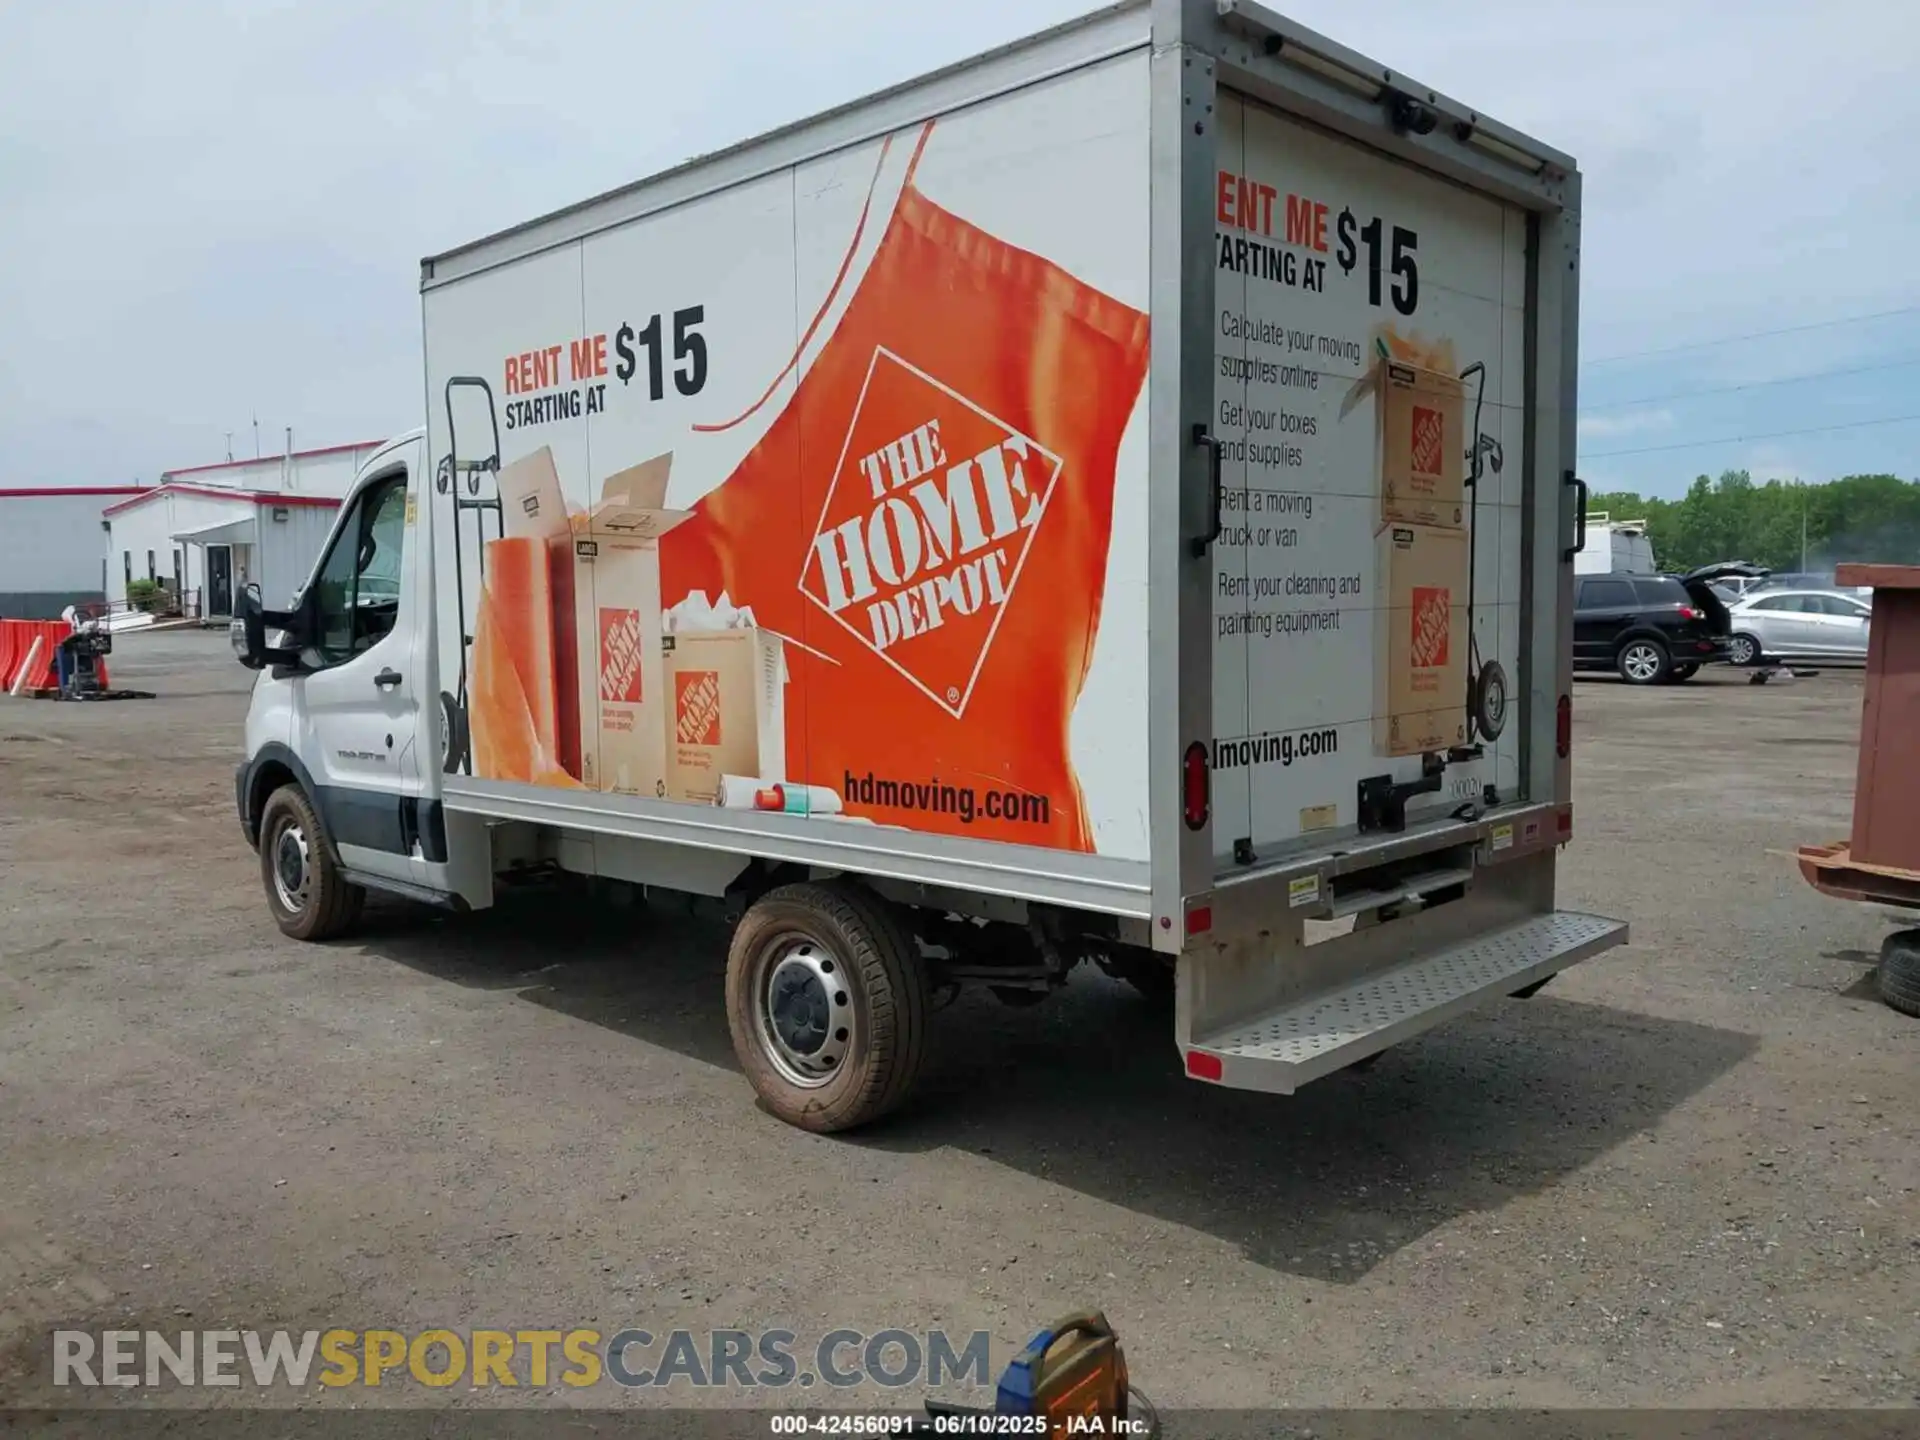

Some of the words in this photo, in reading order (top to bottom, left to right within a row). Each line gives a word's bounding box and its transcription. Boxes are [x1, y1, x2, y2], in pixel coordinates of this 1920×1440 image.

[1286, 193, 1329, 253] ME
[1303, 258, 1326, 293] AT
[1337, 205, 1418, 316] $15
[616, 304, 707, 401] $15
[1221, 310, 1283, 346] Calculate
[1287, 330, 1315, 353] your
[1319, 336, 1360, 366] moving
[505, 346, 562, 395] RENT
[570, 334, 608, 381] ME
[1221, 355, 1277, 385] supplies
[1281, 364, 1318, 390] online
[506, 390, 580, 429] STARTING
[587, 384, 606, 415] AT
[1220, 400, 1243, 426] Get
[1247, 409, 1277, 433] your
[1281, 407, 1317, 435] boxes
[860, 418, 947, 499] THE
[1220, 438, 1245, 461] and
[1249, 442, 1302, 470] supplies
[815, 434, 1042, 613] HOME
[1219, 486, 1250, 511] Rent
[1254, 493, 1262, 512] a
[1267, 492, 1312, 519] moving
[1219, 522, 1253, 546] truck
[1258, 527, 1271, 546] or
[1275, 527, 1297, 547] van
[867, 548, 1008, 651] DEPOT
[1218, 572, 1250, 597] Rent
[1253, 577, 1282, 601] your
[1286, 571, 1336, 599] cleaning
[1339, 573, 1361, 594] and
[1218, 611, 1272, 641] painting
[1276, 608, 1340, 635] equipment
[844, 769, 1050, 823] hdmoving.com
